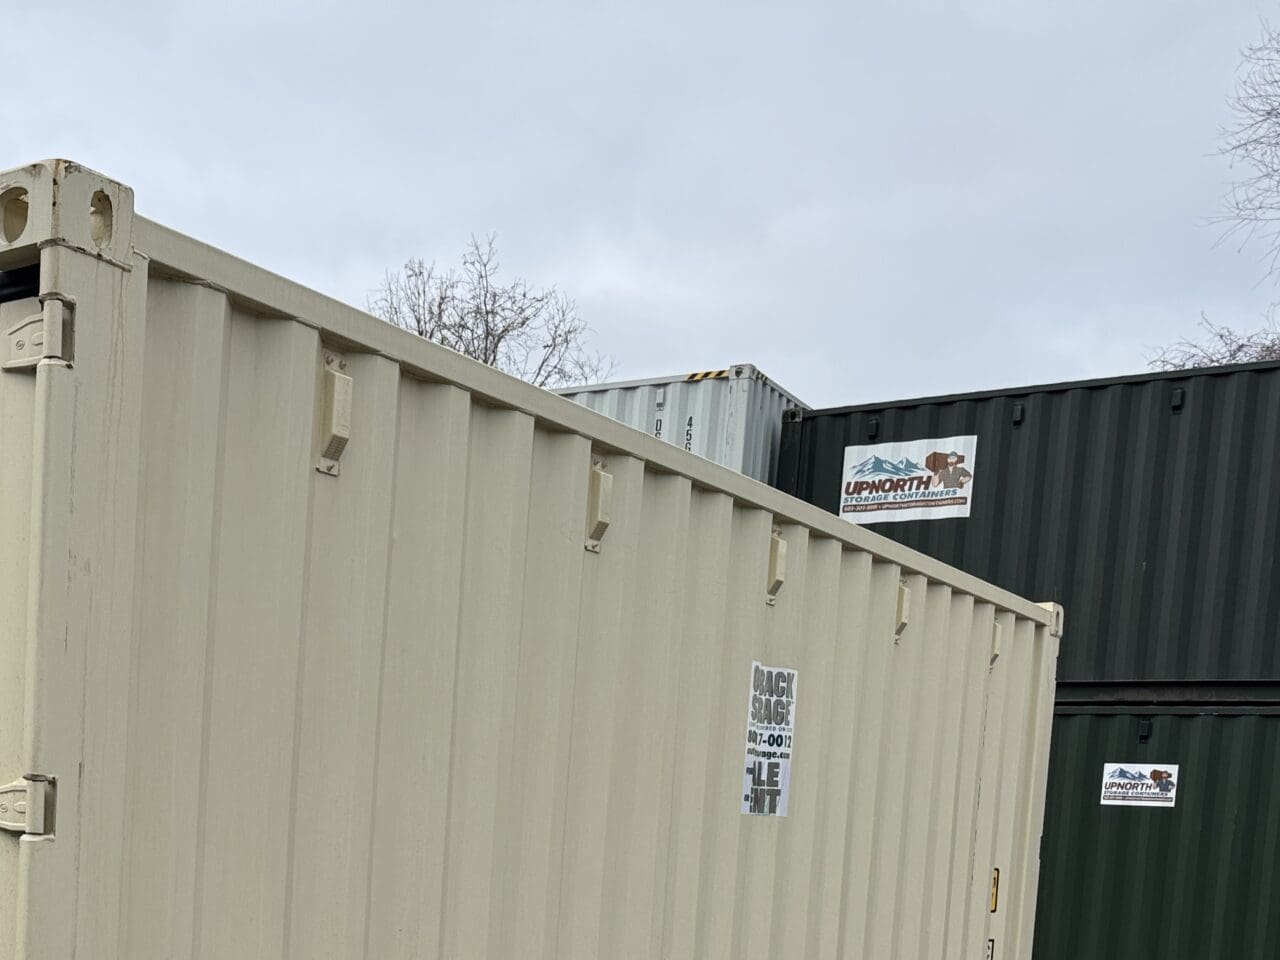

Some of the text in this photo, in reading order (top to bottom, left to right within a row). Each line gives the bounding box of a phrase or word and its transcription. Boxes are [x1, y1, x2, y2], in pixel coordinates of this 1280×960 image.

[844, 476, 932, 496] UPNORTH
[843, 489, 958, 504] STORAGE CONTAINERS
[1105, 782, 1152, 791] UPNORTH
